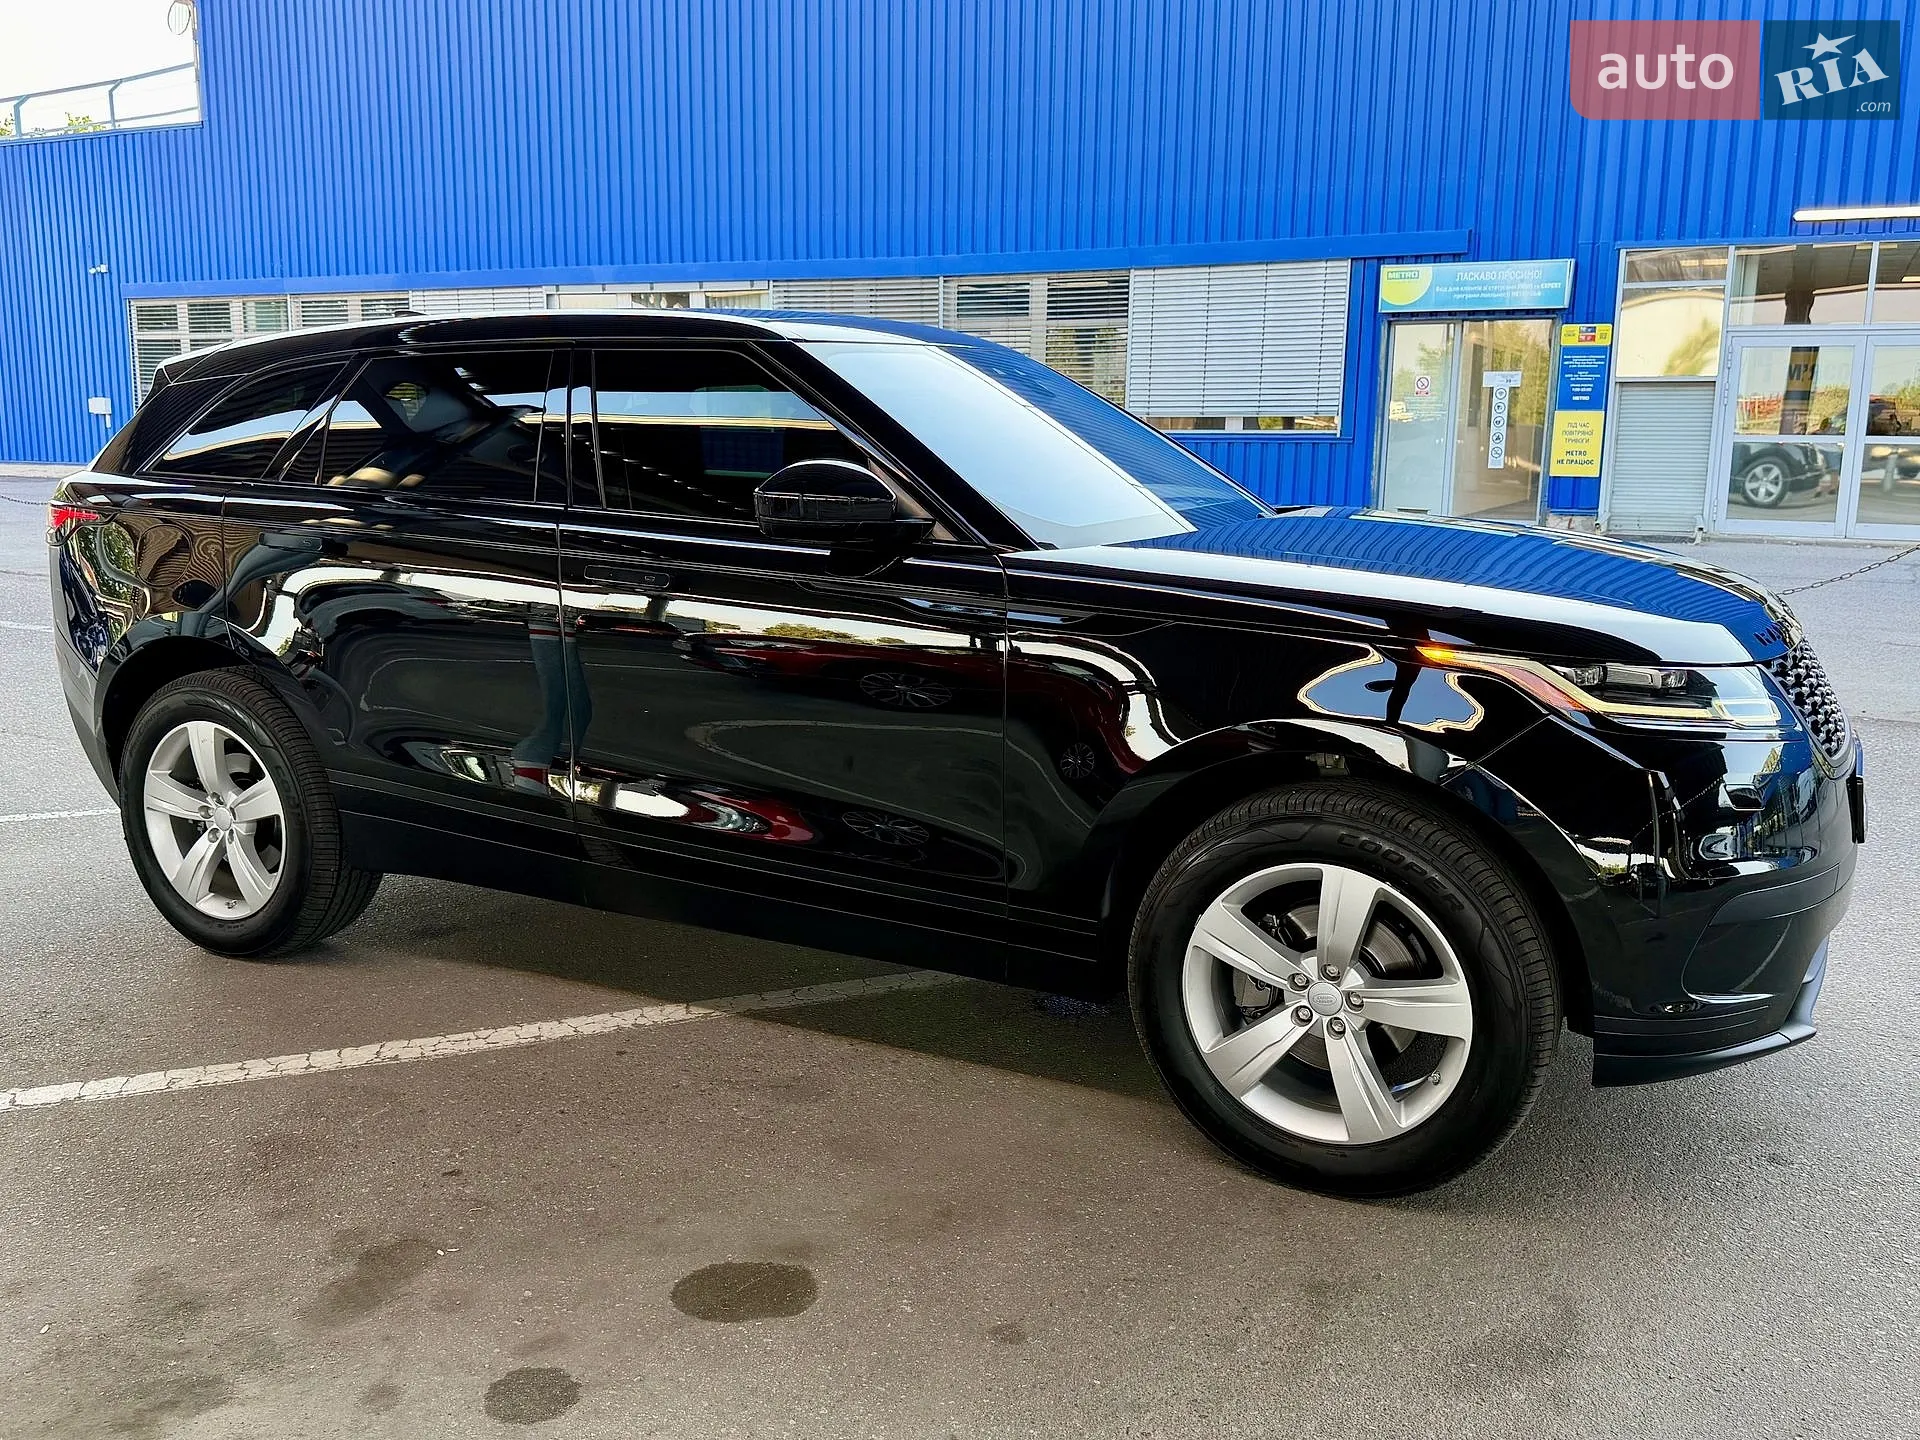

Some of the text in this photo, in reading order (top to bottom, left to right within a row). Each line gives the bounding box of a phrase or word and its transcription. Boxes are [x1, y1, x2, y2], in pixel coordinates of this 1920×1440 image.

[1387, 270, 1419, 280] METRO
[1456, 269, 1543, 281] ЛАСКАВО ПРОСИМО!
[1337, 831, 1465, 911] COOPER
